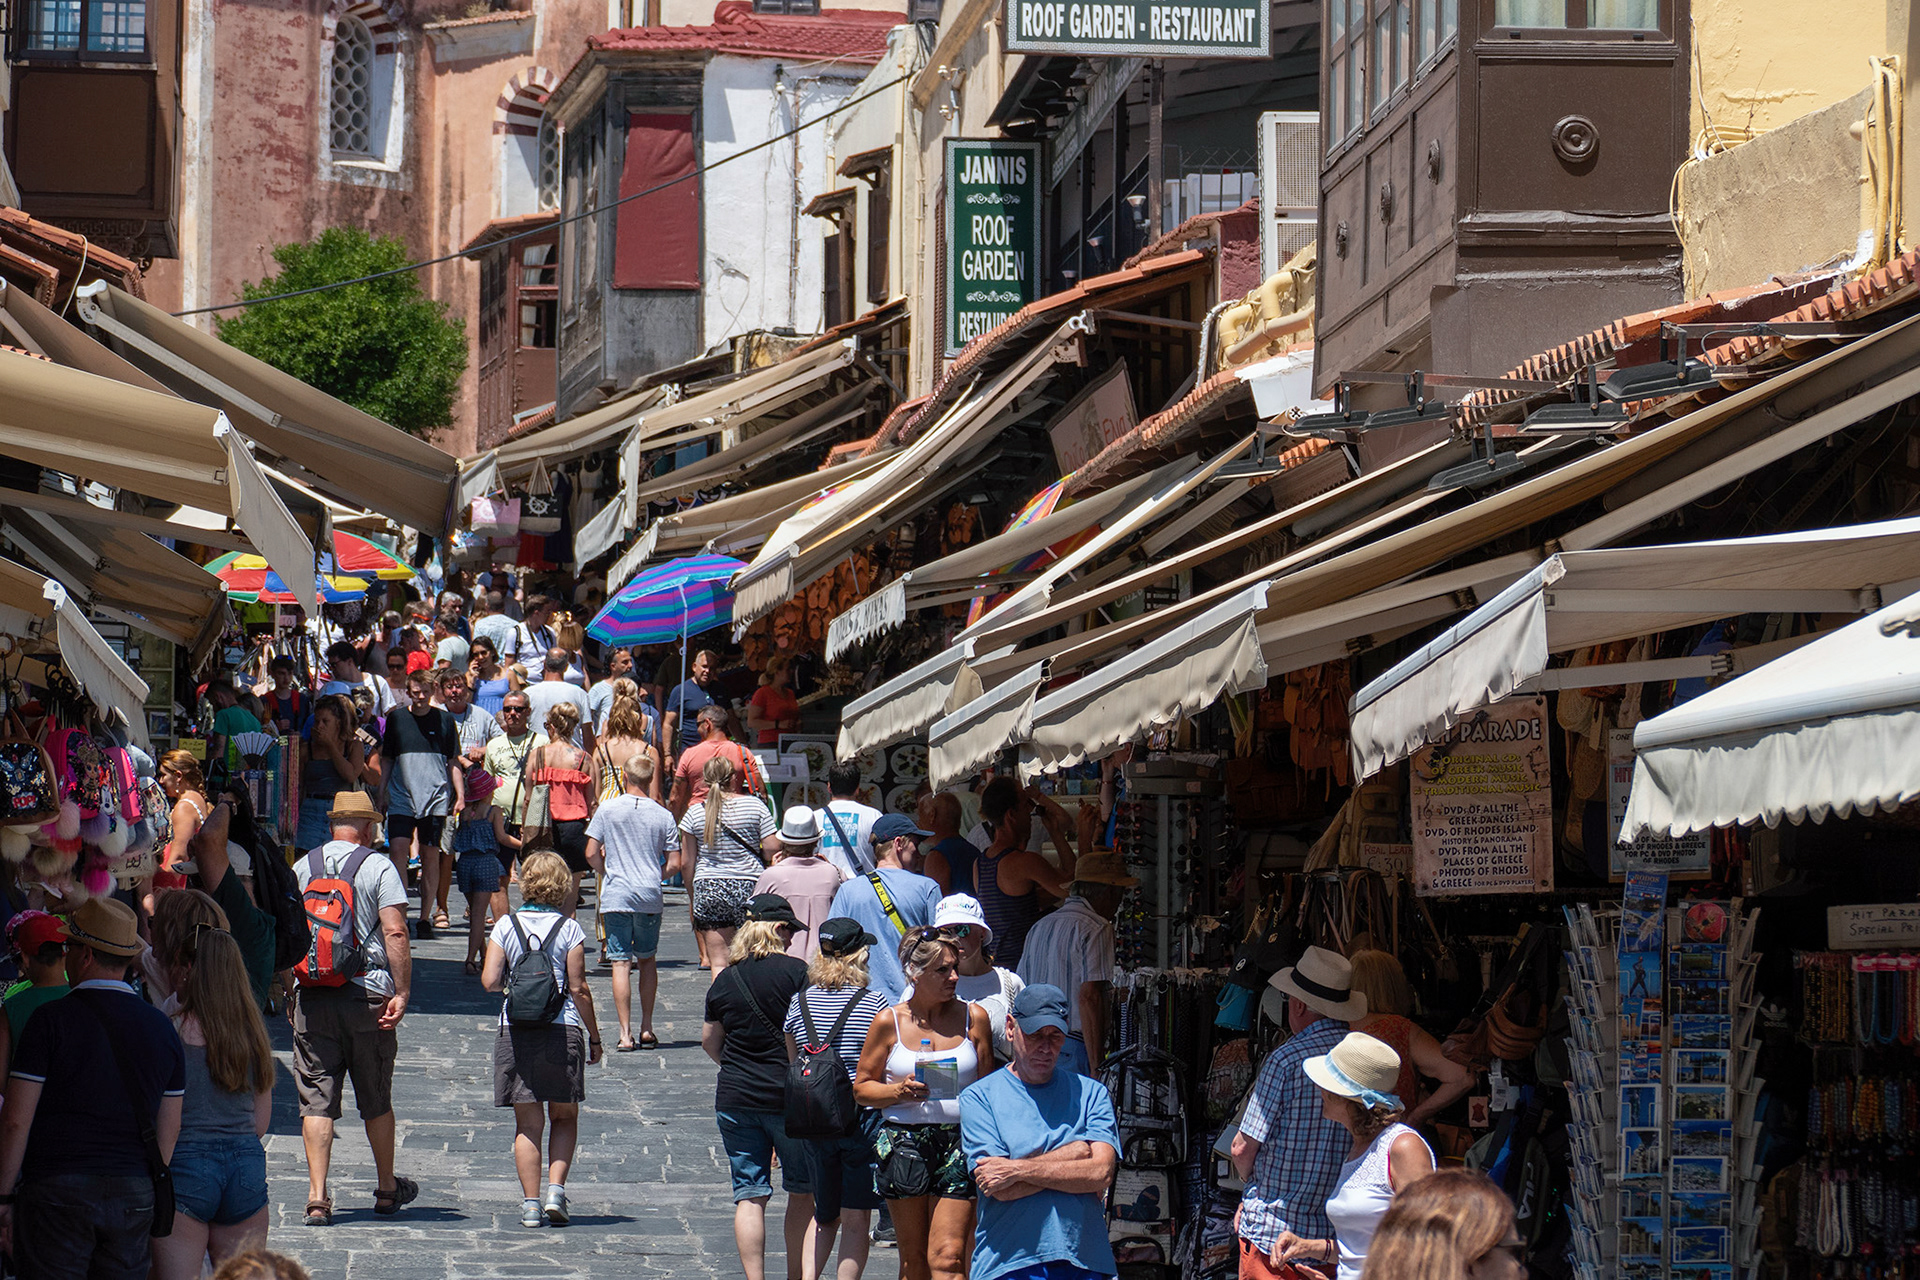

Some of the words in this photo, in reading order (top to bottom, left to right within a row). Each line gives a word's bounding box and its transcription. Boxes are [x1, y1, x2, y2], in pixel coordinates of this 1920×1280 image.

[1021, 2, 1065, 37] ROOF
[1069, 3, 1135, 39] GARDEN
[1150, 5, 1256, 42] RESTAURANT
[960, 155, 1027, 185] JANNIS
[972, 215, 1014, 246] ROOF
[961, 250, 1025, 281] GARDEN
[959, 311, 1013, 342] RESTAU
[1460, 718, 1541, 743] PARADE
[1442, 753, 1500, 764] ORIGINAL
[1431, 766, 1446, 775] OF
[1449, 764, 1485, 775] GREEK
[1487, 763, 1524, 773] MUSIC
[1614, 767, 1633, 783] HIT
[1437, 774, 1488, 785] MODERN
[1491, 773, 1528, 783] MUSIC
[1424, 784, 1503, 796] TRADITIONAL
[1505, 783, 1541, 793] MUSIC
[1469, 805, 1481, 814] OF
[1483, 804, 1499, 813] ALL
[1501, 803, 1519, 812] THE
[1449, 815, 1477, 826] GREEK
[1479, 814, 1515, 824] DANCES
[1450, 827, 1463, 836] OF
[1464, 826, 1501, 835] RHODES
[1503, 824, 1540, 834] ISLAND:
[1441, 837, 1472, 846] HISTORY
[1480, 835, 1523, 844] PANORAMA
[1646, 842, 1674, 850] RHODES
[1681, 841, 1706, 849] GREECE
[1388, 844, 1413, 855] LEATH
[1462, 846, 1489, 855] FROM
[1491, 845, 1508, 854] ALL
[1509, 844, 1528, 853] THE
[1625, 850, 1638, 858] FOR
[1658, 849, 1671, 857] DVD
[1672, 849, 1697, 857] PHOTOS
[1443, 857, 1475, 867] PLACES
[1476, 856, 1489, 865] OF
[1491, 855, 1523, 865] GREECE
[1439, 867, 1475, 877] PHOTOS
[1478, 866, 1489, 875] OF
[1492, 865, 1529, 875] RHODES
[1432, 879, 1439, 888] &
[1441, 878, 1472, 888] GREECE
[1882, 907, 1920, 917] PARA
[1901, 922, 1920, 933] PRI
